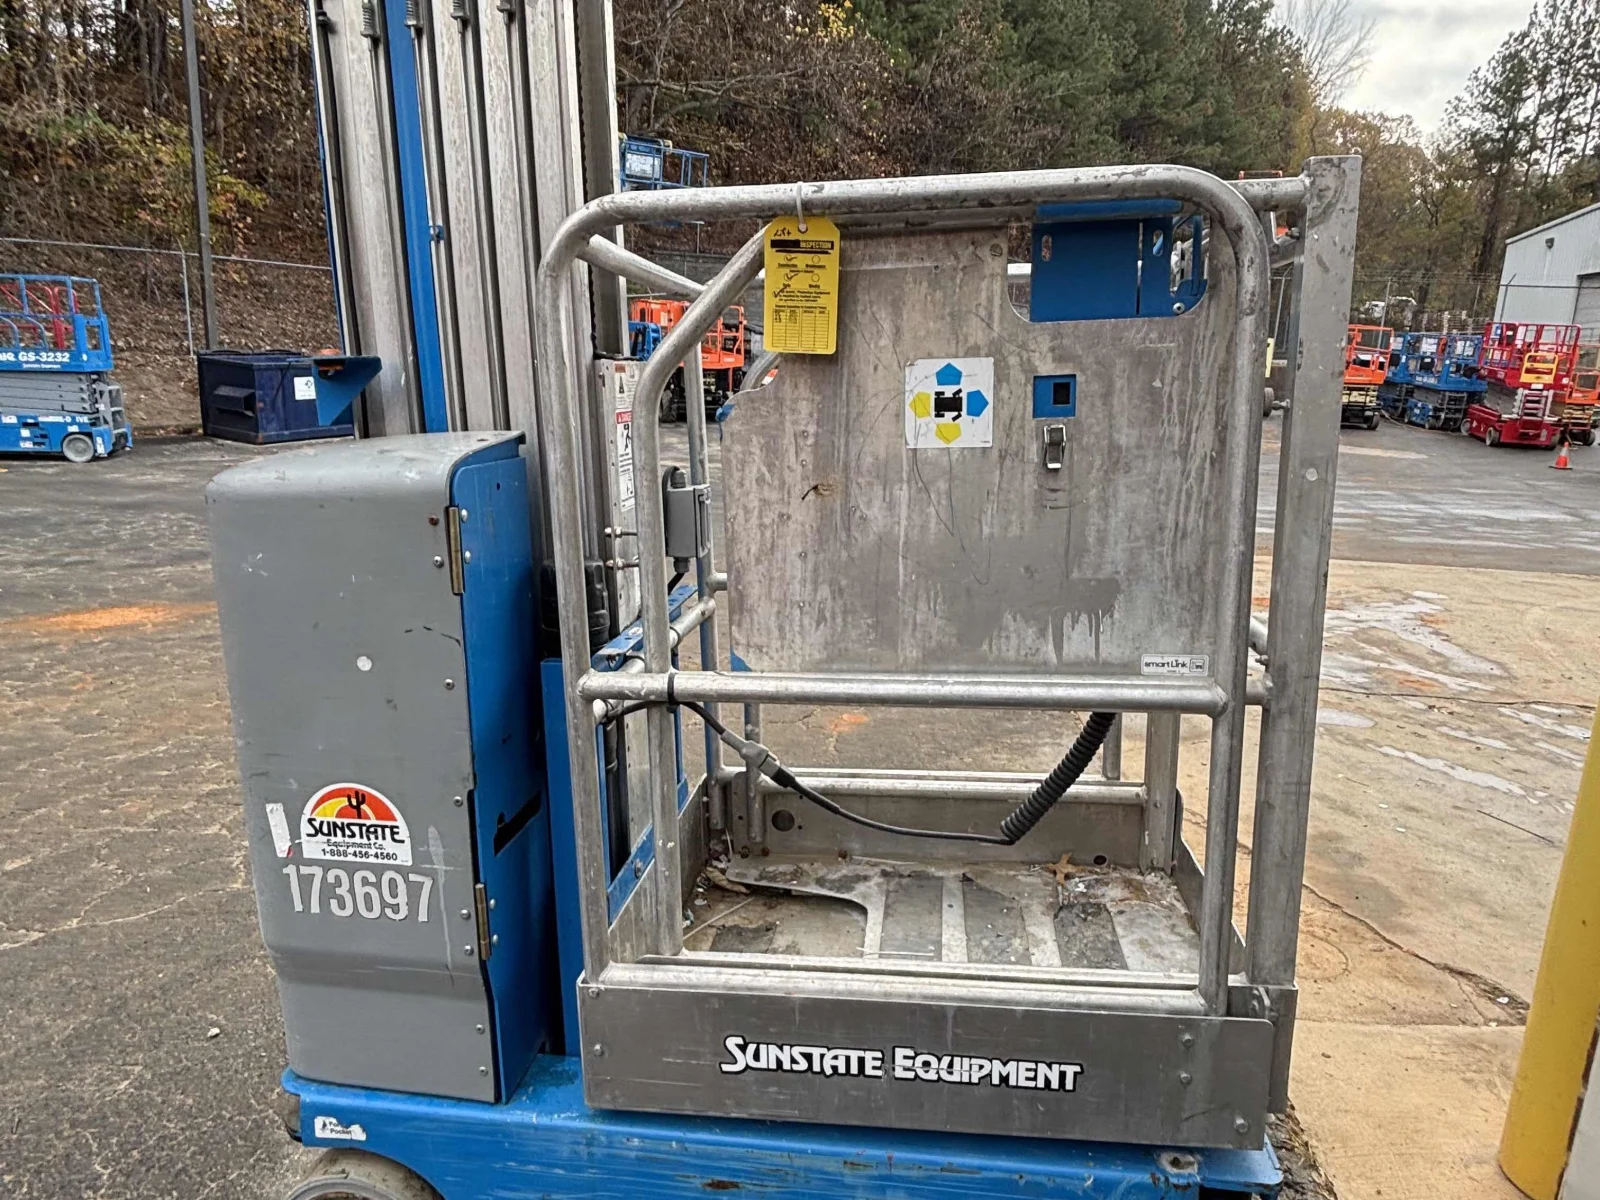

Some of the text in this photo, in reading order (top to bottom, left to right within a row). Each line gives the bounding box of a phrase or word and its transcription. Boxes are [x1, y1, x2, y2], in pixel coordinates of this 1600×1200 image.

[800, 241, 831, 249] INSPECTION
[18, 352, 70, 362] GS-3232
[306, 817, 405, 844] SUNSTATE
[327, 838, 386, 850] Equipment Co.
[321, 848, 398, 861] 1-888-456-4560
[282, 864, 433, 922] 173697
[720, 1035, 1082, 1092] SUNSTATE EQUIPMENT
